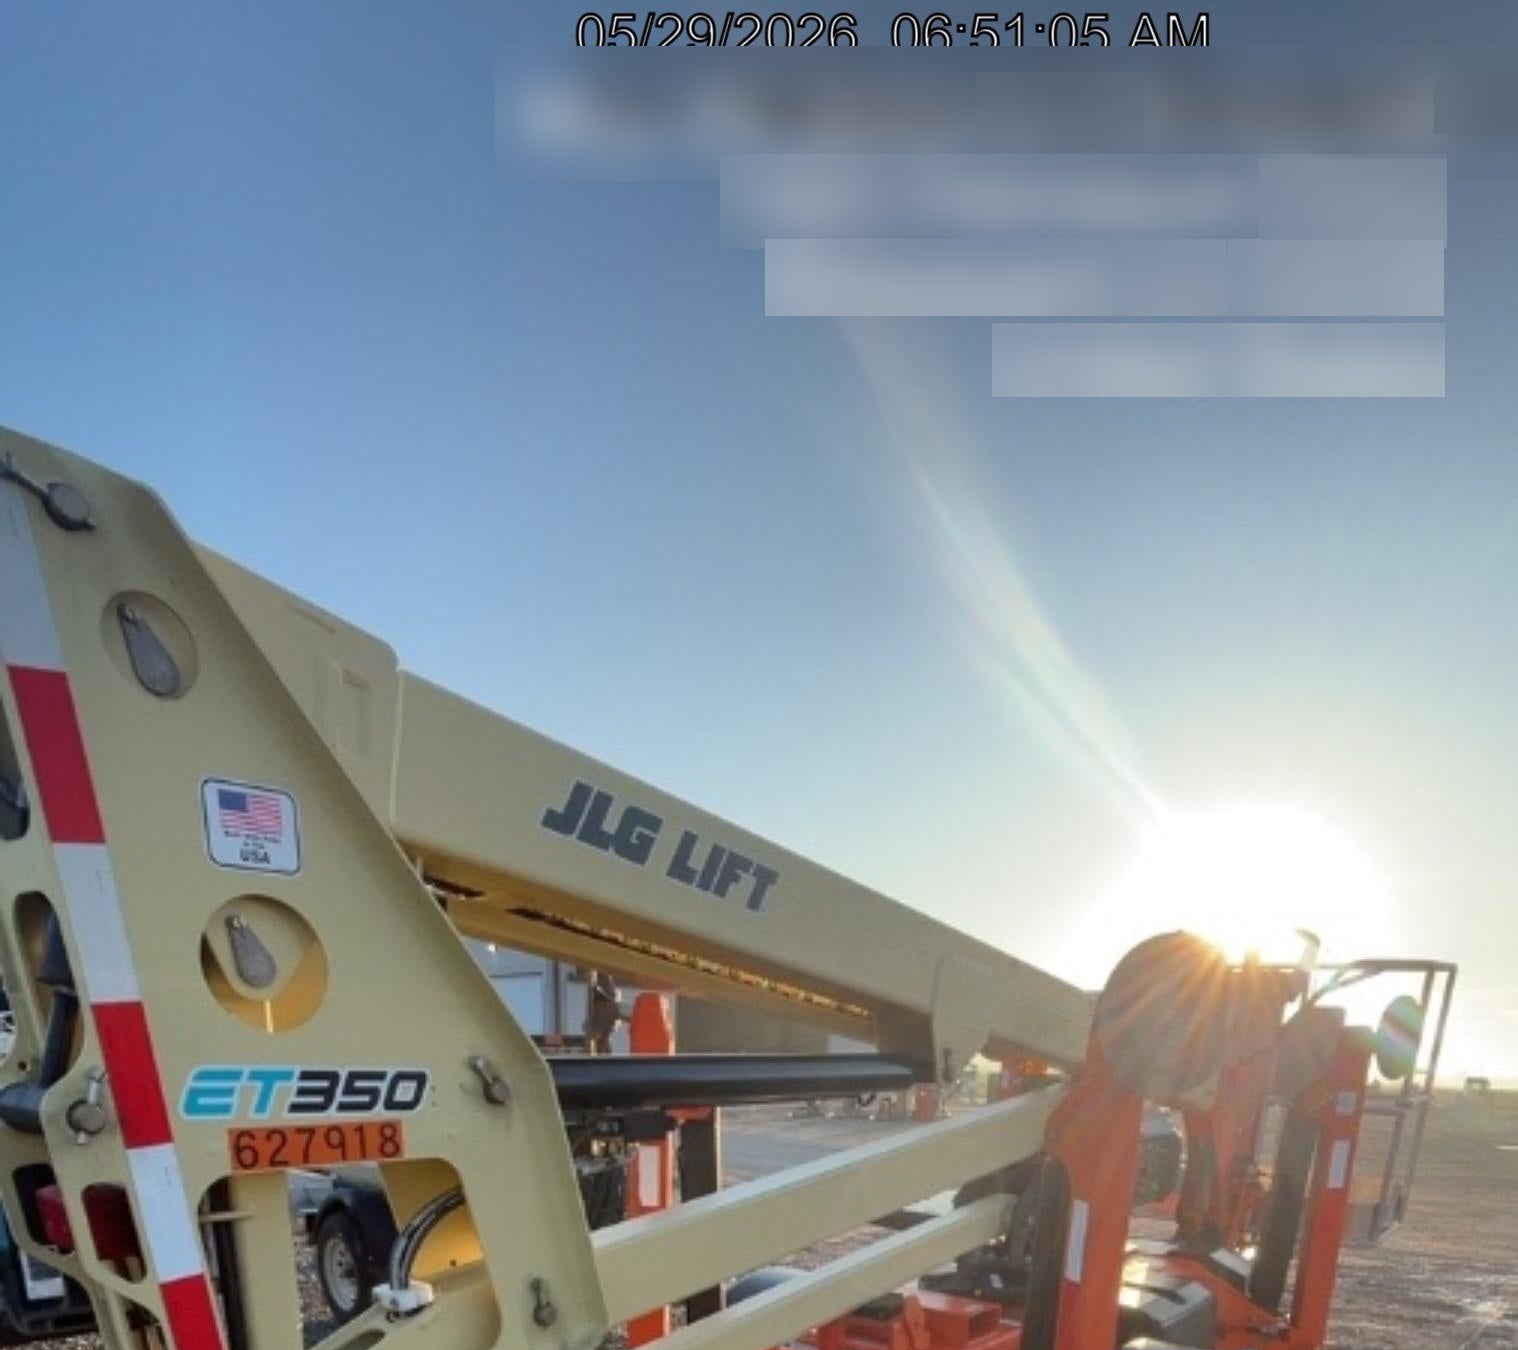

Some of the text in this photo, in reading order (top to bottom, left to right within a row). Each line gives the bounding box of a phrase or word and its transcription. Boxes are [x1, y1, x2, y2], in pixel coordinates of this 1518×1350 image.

[239, 847, 271, 865] USA
[541, 780, 780, 912] JLG LIFT
[181, 1068, 428, 1117] ET350
[233, 1122, 401, 1170] 627918
